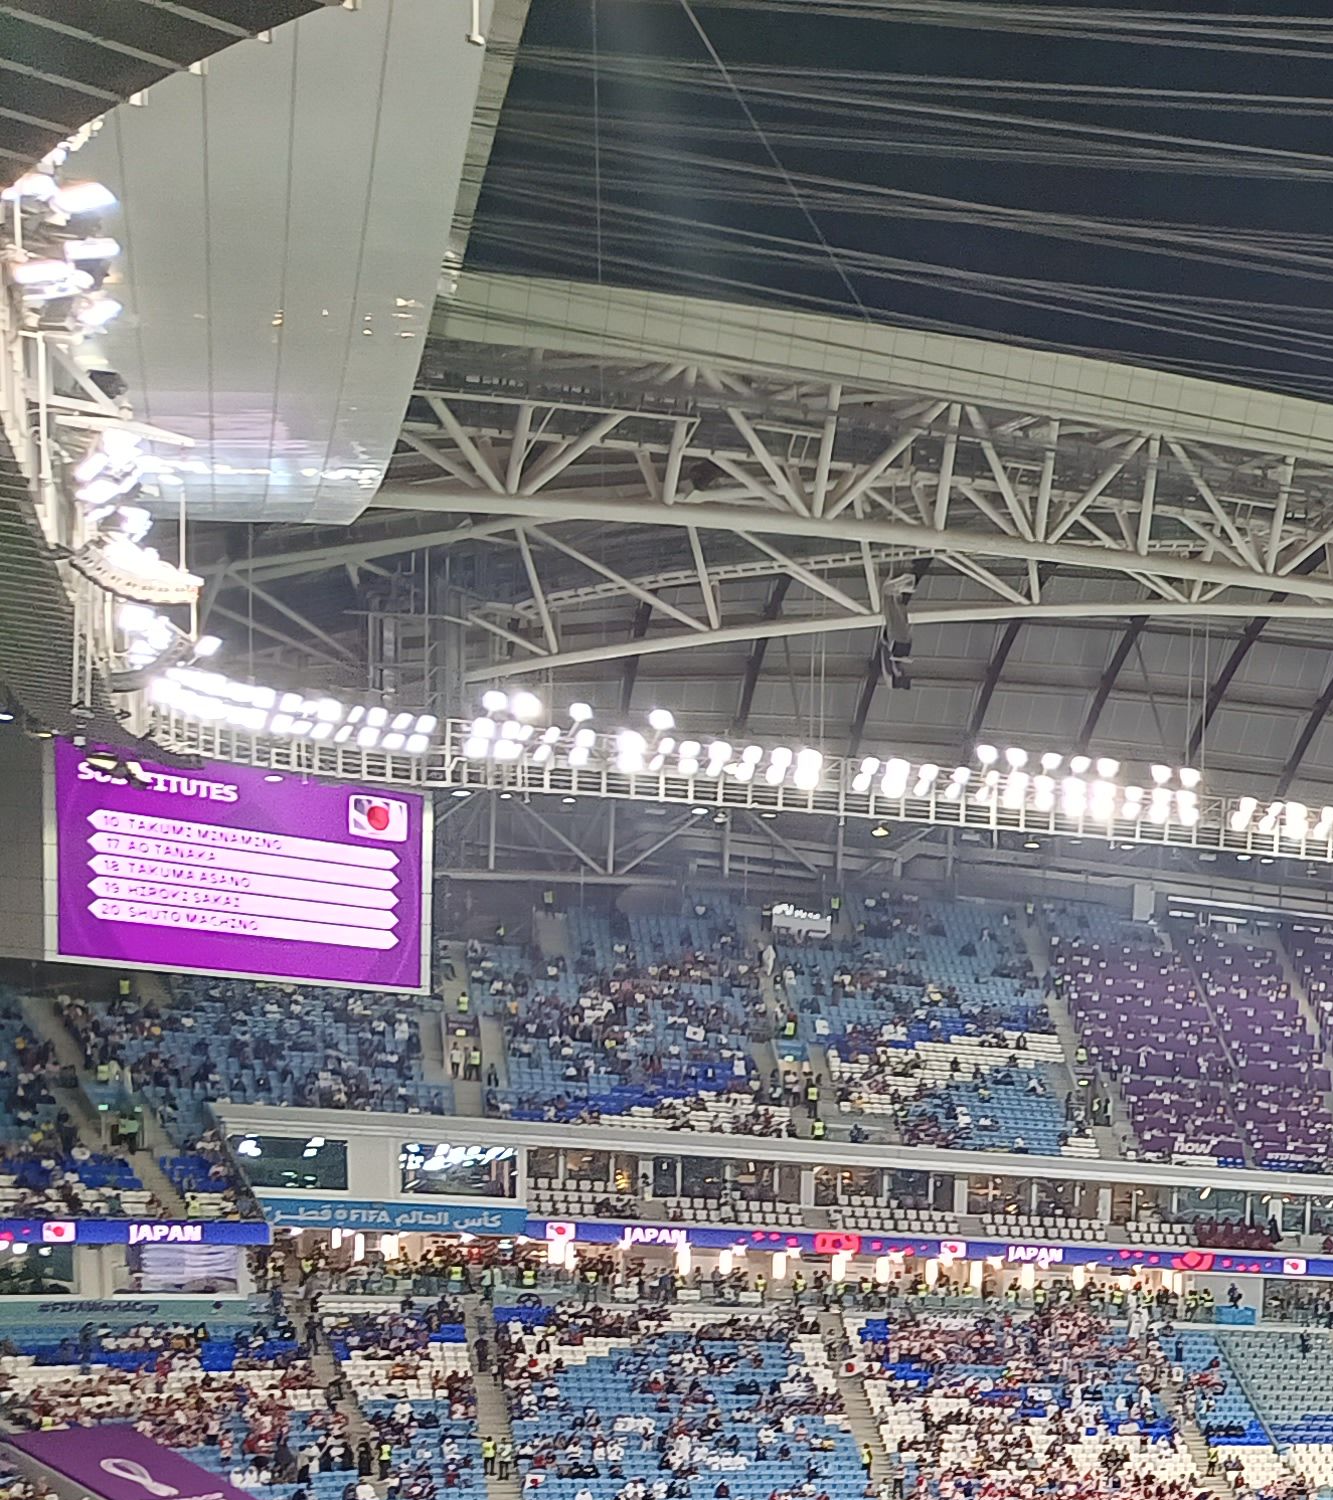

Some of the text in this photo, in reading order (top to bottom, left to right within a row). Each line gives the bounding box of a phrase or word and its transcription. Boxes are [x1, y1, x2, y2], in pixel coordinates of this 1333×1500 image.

[350, 1209, 391, 1224] FIFA
[128, 1224, 202, 1245] JAPAN
[624, 1227, 687, 1245] JAPAN
[1007, 1246, 1063, 1262] JAPAN
